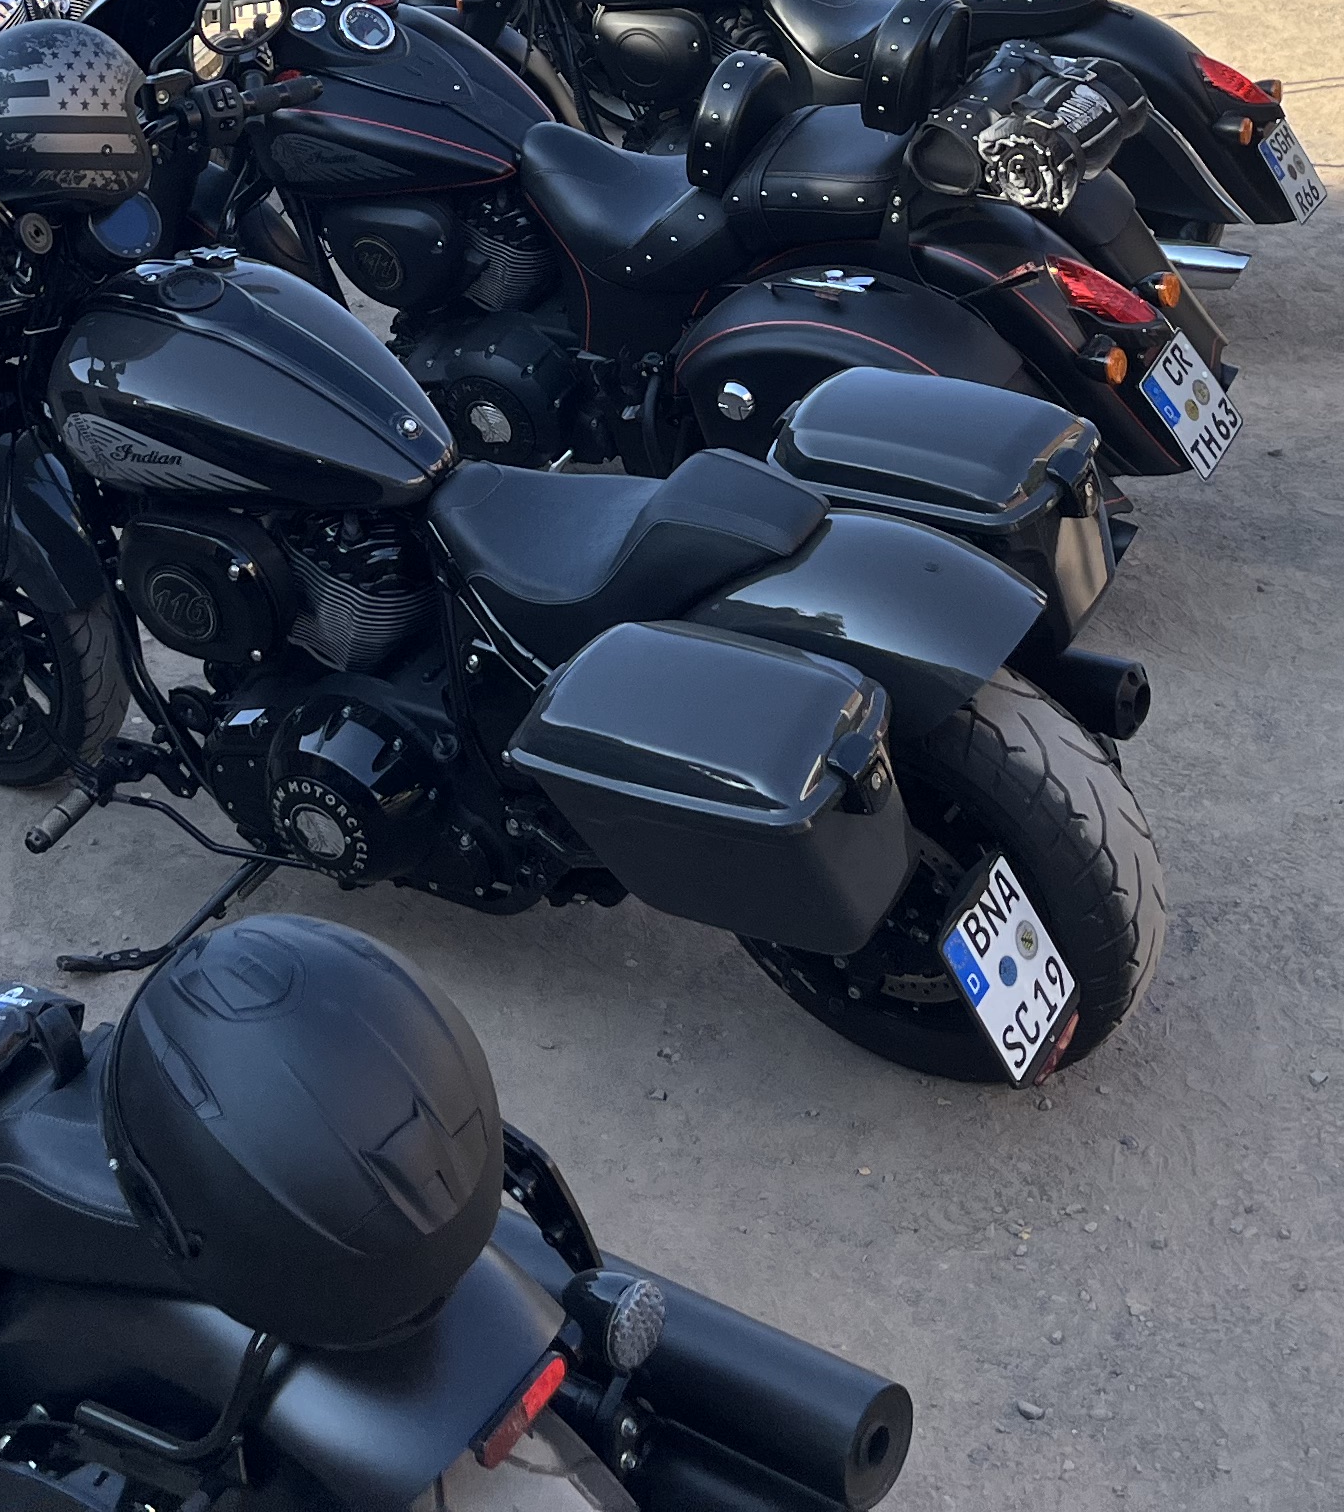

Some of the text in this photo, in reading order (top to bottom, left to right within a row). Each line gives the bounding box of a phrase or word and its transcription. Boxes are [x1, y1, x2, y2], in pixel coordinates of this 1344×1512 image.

[1268, 124, 1296, 162] SGH
[1161, 342, 1194, 387] CR
[109, 443, 183, 467] Indian
[287, 780, 369, 870] MOTORCYCLE
[962, 869, 1021, 959] BNA
[966, 973, 981, 996] D
